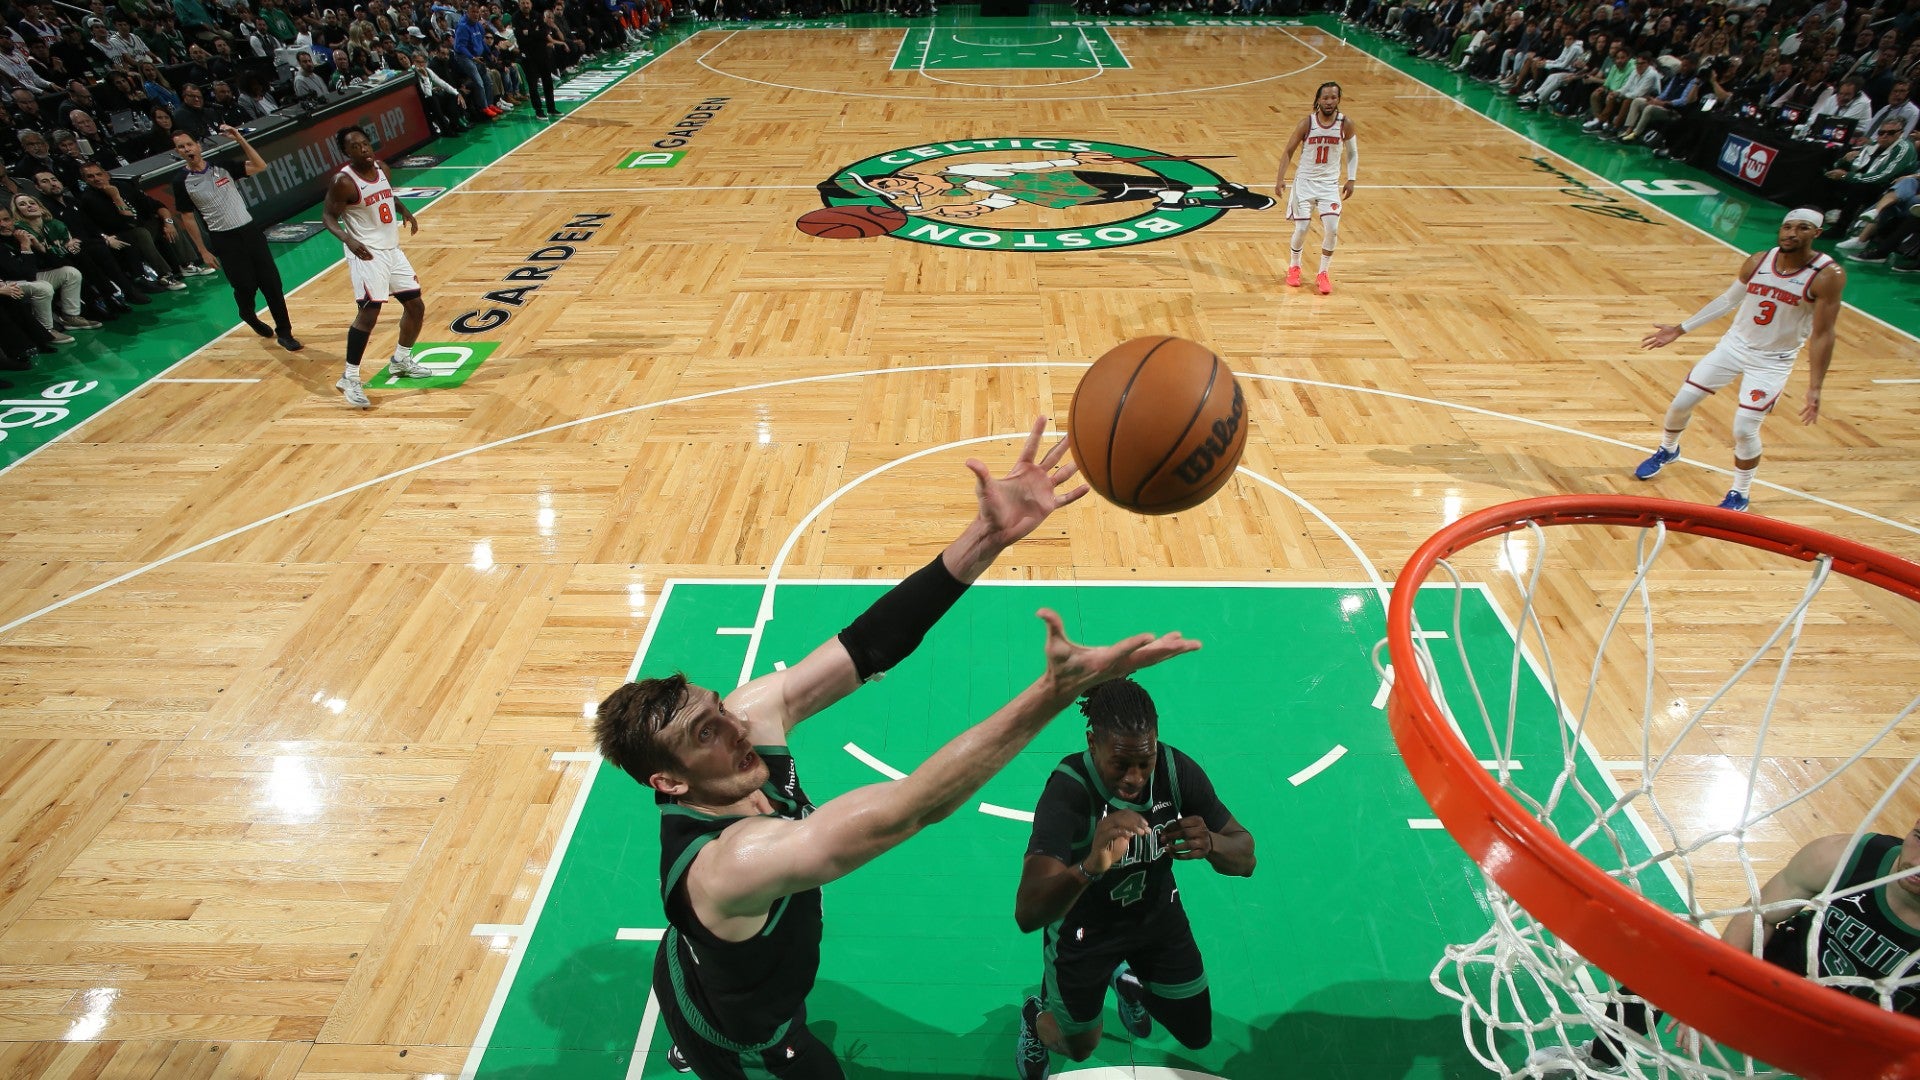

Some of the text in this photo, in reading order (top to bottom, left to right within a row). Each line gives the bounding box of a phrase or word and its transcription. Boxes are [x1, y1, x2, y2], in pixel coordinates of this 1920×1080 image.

[651, 97, 732, 149] GARDEN
[266, 153, 303, 195] THE
[298, 142, 331, 180] ALL
[380, 106, 405, 142] APP
[879, 139, 1093, 165] CELTICS
[1316, 146, 1329, 164] 11
[379, 202, 393, 224] 8
[908, 217, 1185, 248] BOSTON
[449, 212, 616, 334] GARDEN
[1746, 283, 1802, 306] NEW YORK
[1754, 300, 1777, 326] 3
[0, 380, 98, 441] gle
[1110, 870, 1147, 907] 4
[1823, 905, 1920, 975] CELTI
